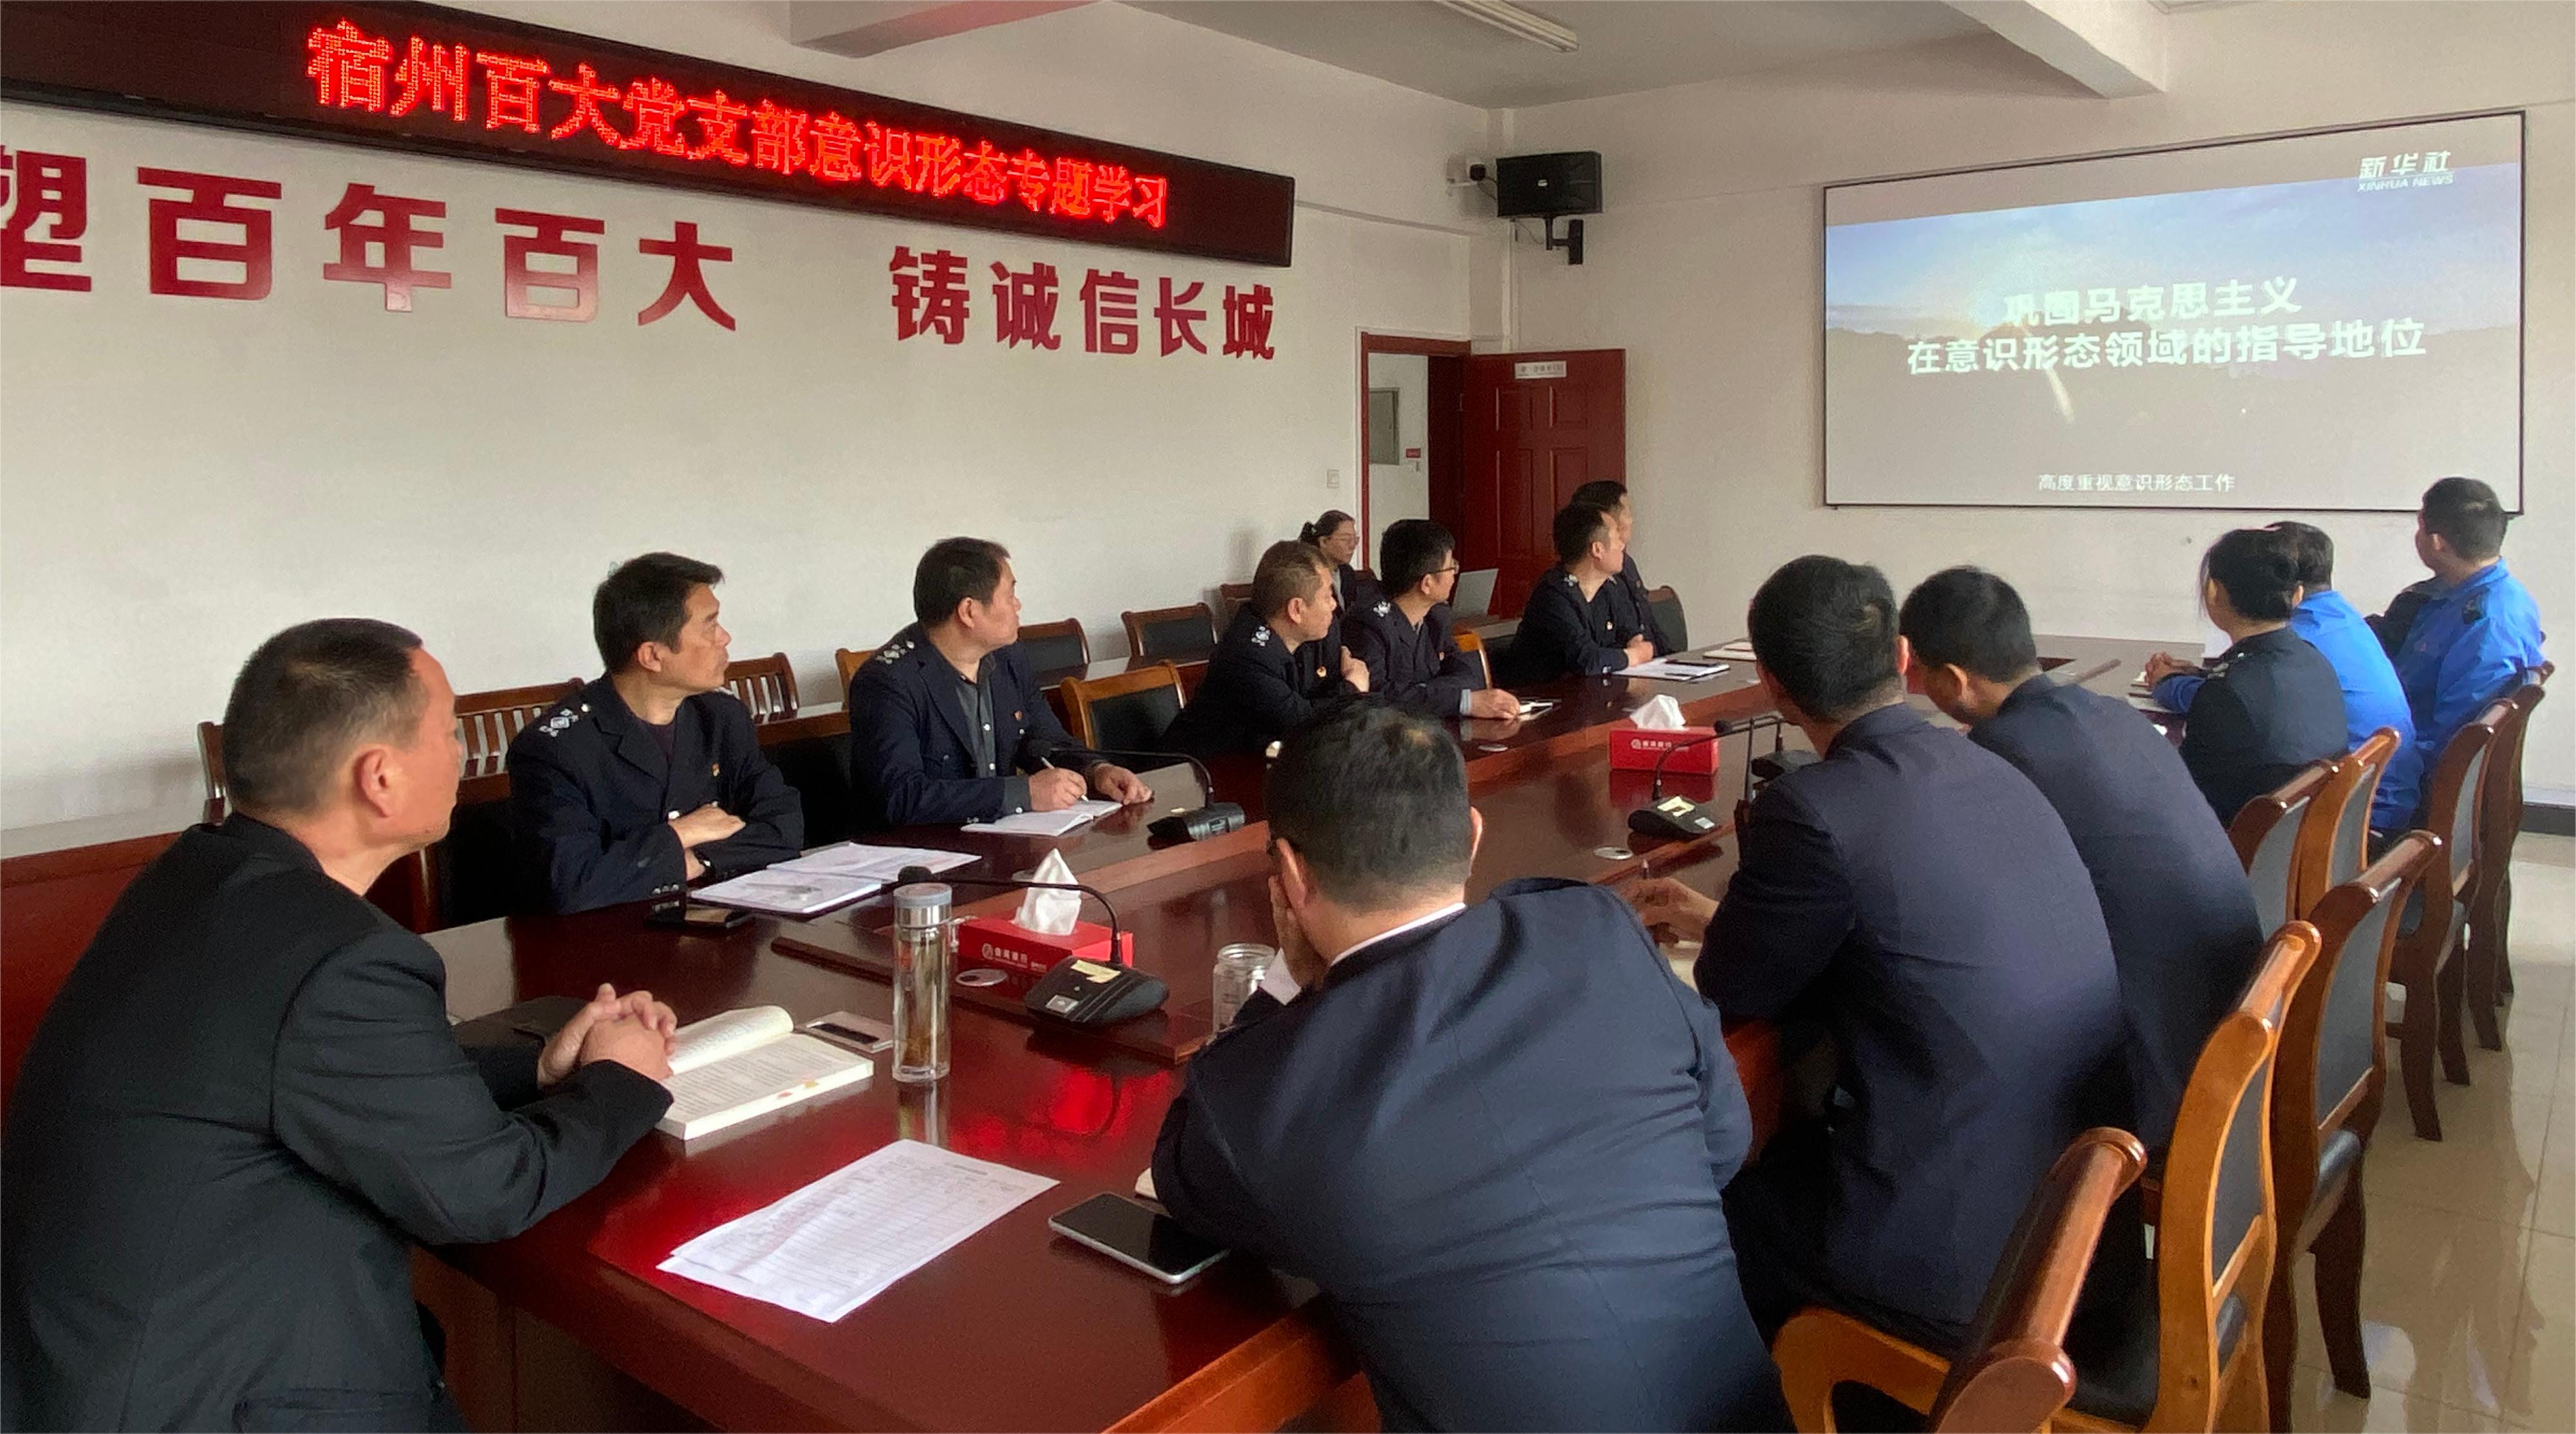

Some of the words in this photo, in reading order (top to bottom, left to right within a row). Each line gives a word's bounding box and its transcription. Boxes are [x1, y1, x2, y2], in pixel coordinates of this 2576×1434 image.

[307, 18, 1167, 228] 宿州百大党支部意识形态专题学习
[2357, 178, 2409, 192] XINHUA
[2412, 173, 2454, 187] NEWS
[2359, 150, 2451, 179] 新华社
[889, 245, 1274, 360] 铸诚信长城
[2002, 275, 2303, 327] 巩固马克思主义
[1907, 317, 2426, 375] 在意识形态领域的指导地位
[2038, 473, 2236, 492] 高度重视意识形态工作
